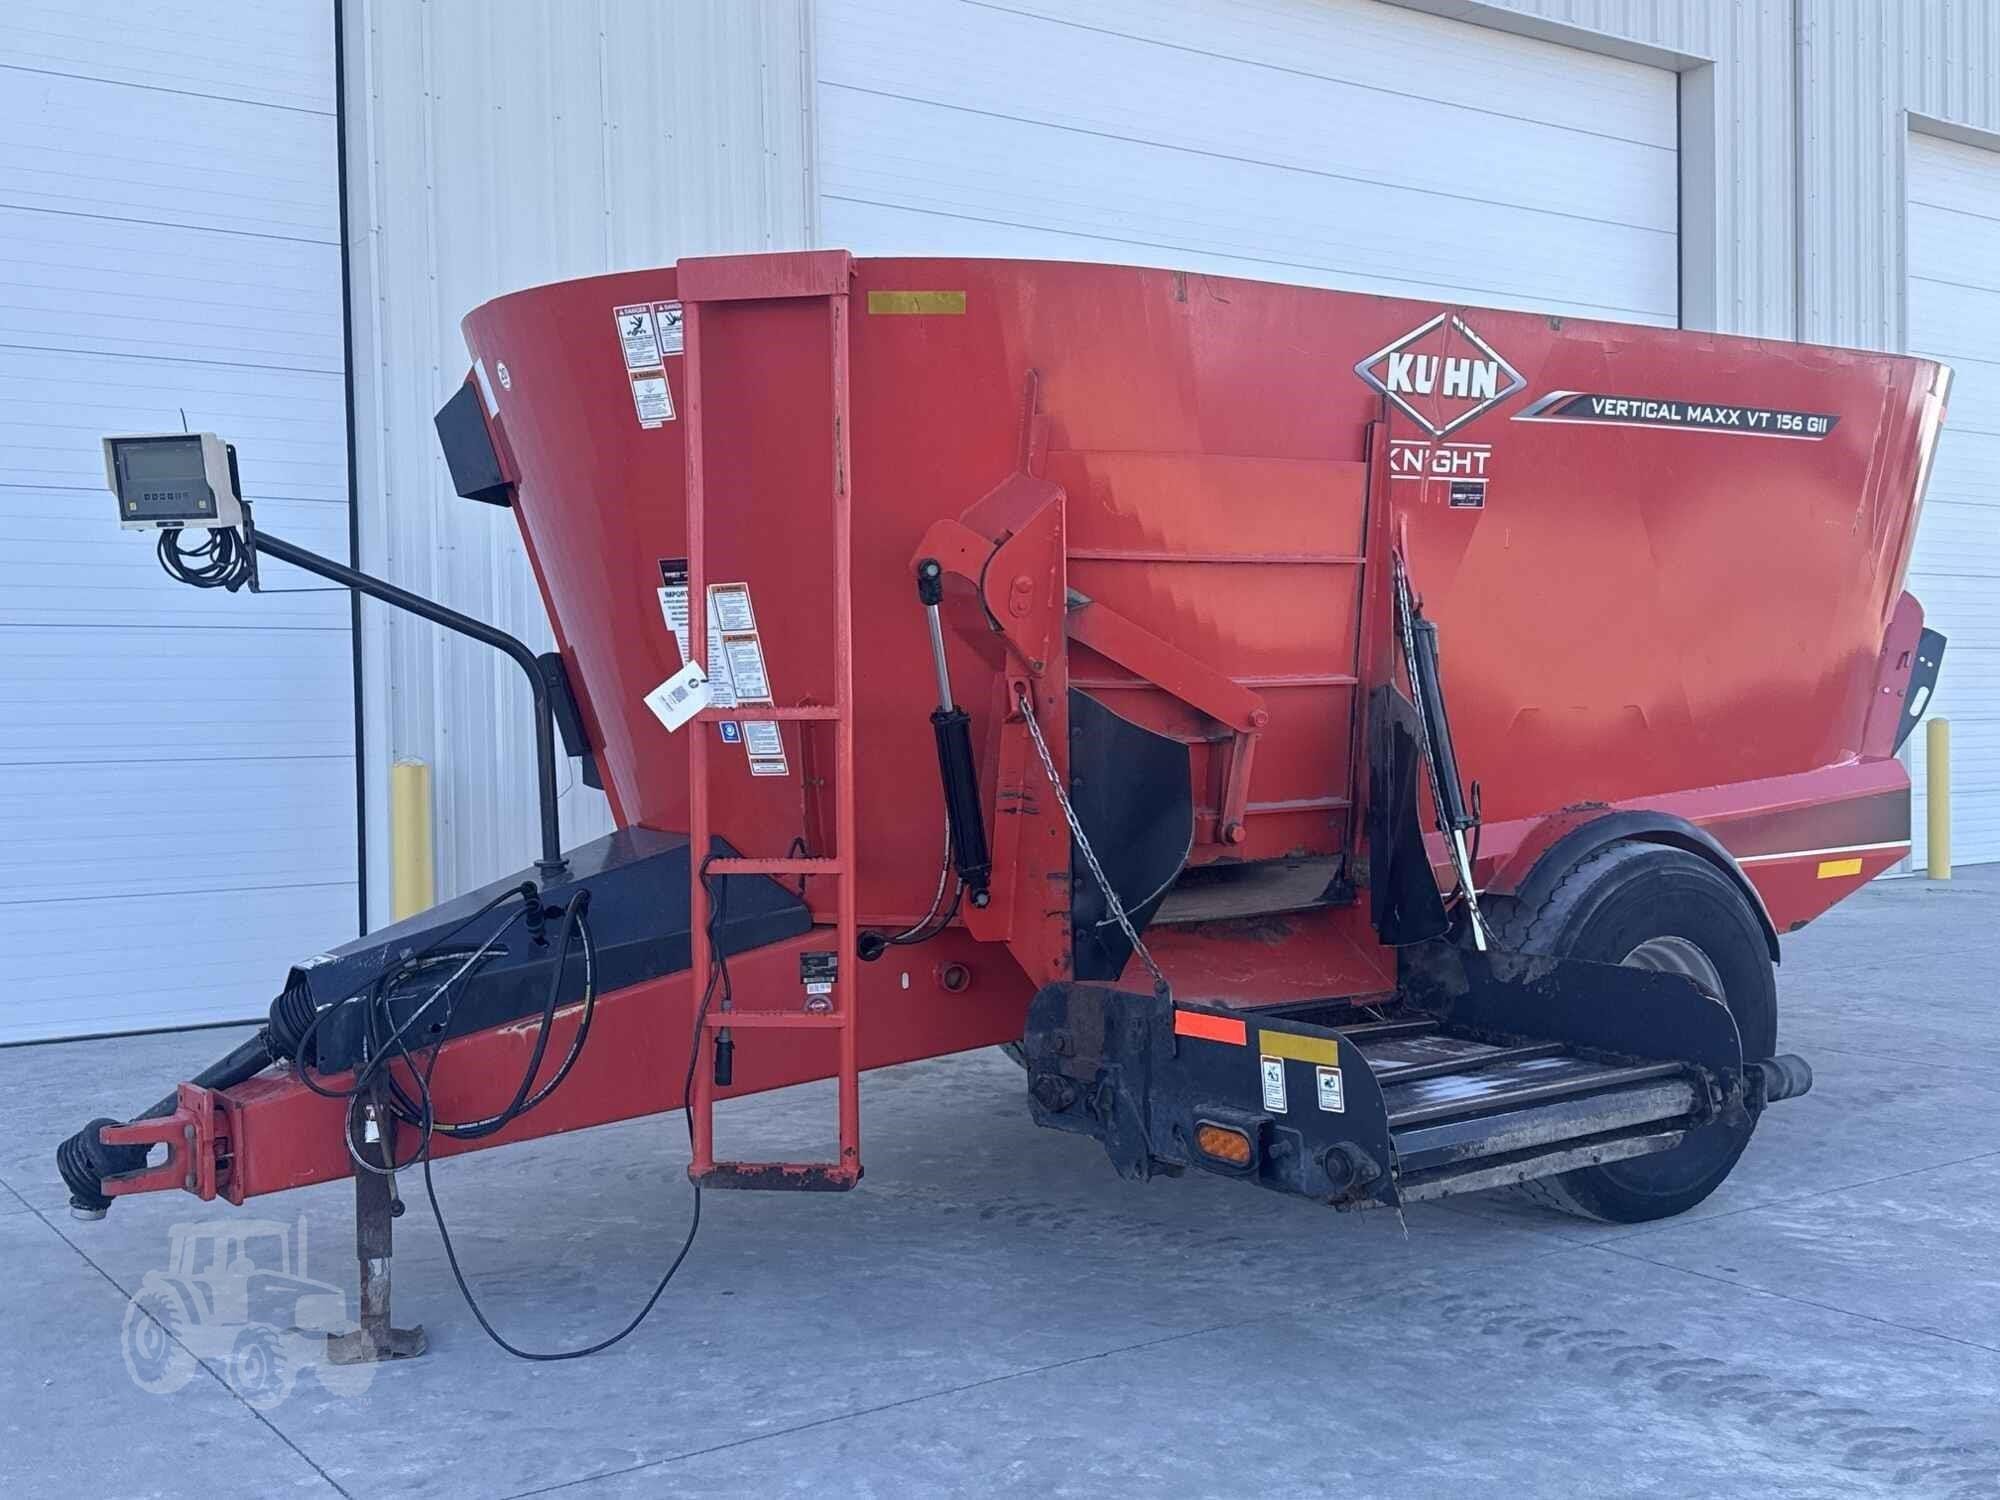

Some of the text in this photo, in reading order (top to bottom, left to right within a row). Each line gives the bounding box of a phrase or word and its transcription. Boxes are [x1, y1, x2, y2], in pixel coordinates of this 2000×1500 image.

[1385, 352, 1498, 400] KUHN
[1592, 397, 1828, 434] VERTICAL MAXX VT 156 GII
